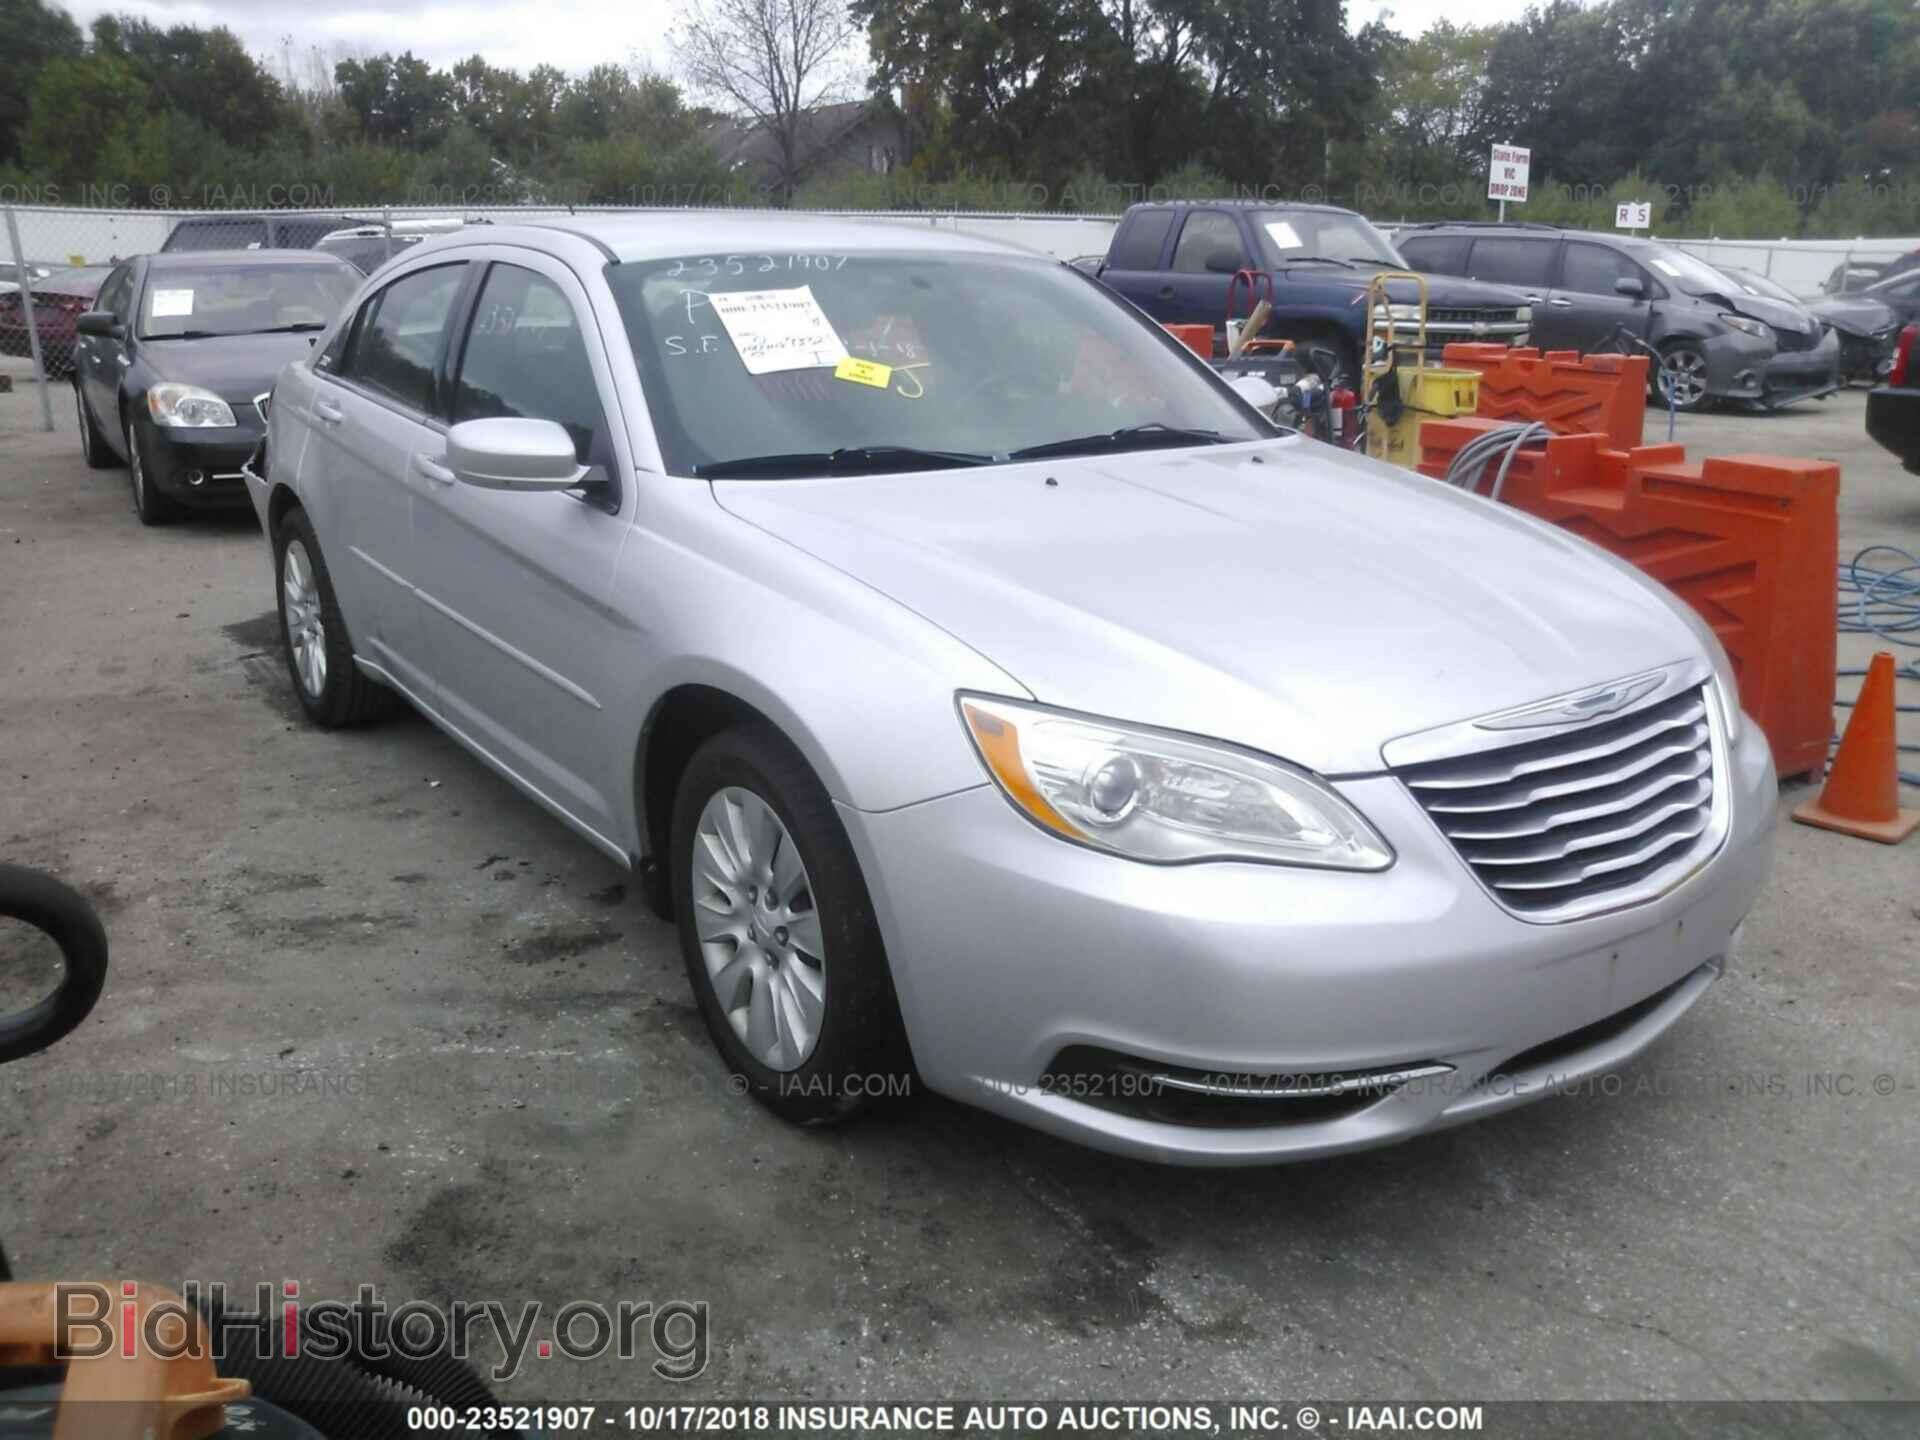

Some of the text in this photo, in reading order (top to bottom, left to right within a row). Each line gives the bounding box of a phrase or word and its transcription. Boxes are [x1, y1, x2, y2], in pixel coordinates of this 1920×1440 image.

[1490, 183, 1526, 199] DROP ZONE
[1619, 209, 1647, 222] R S
[667, 254, 848, 276] 23521907
